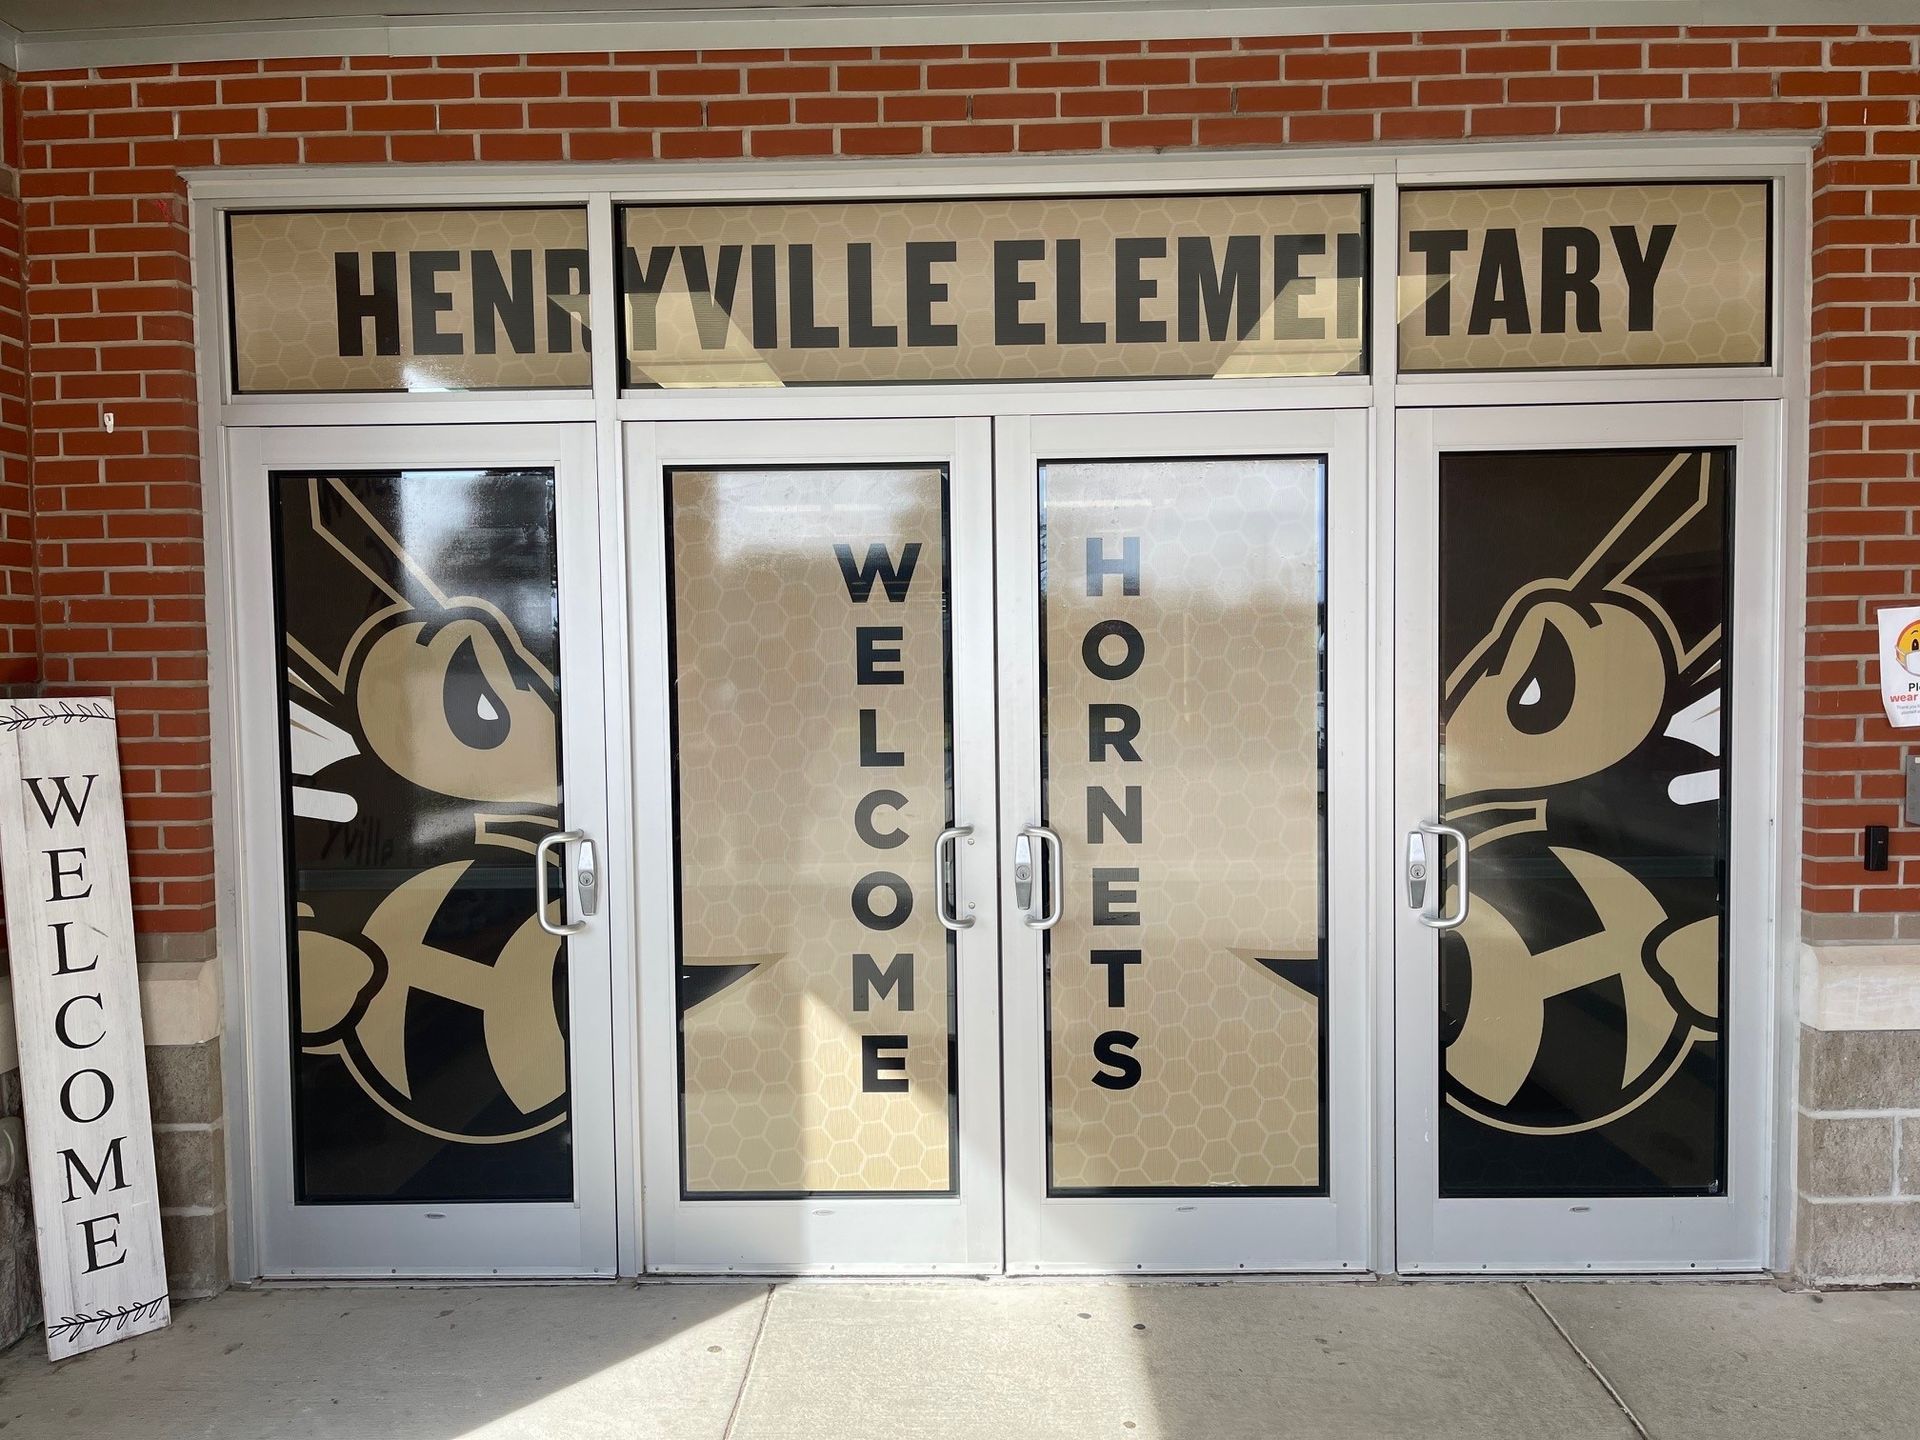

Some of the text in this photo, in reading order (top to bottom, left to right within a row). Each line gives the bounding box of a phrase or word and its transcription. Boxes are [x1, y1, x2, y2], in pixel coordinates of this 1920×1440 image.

[334, 240, 957, 357] HENRYVILLE
[833, 542, 923, 1093] WELCOME
[1081, 536, 1146, 1091] HORNETS
[1889, 693, 1919, 702] wear
[21, 773, 133, 1275] WELCOME
